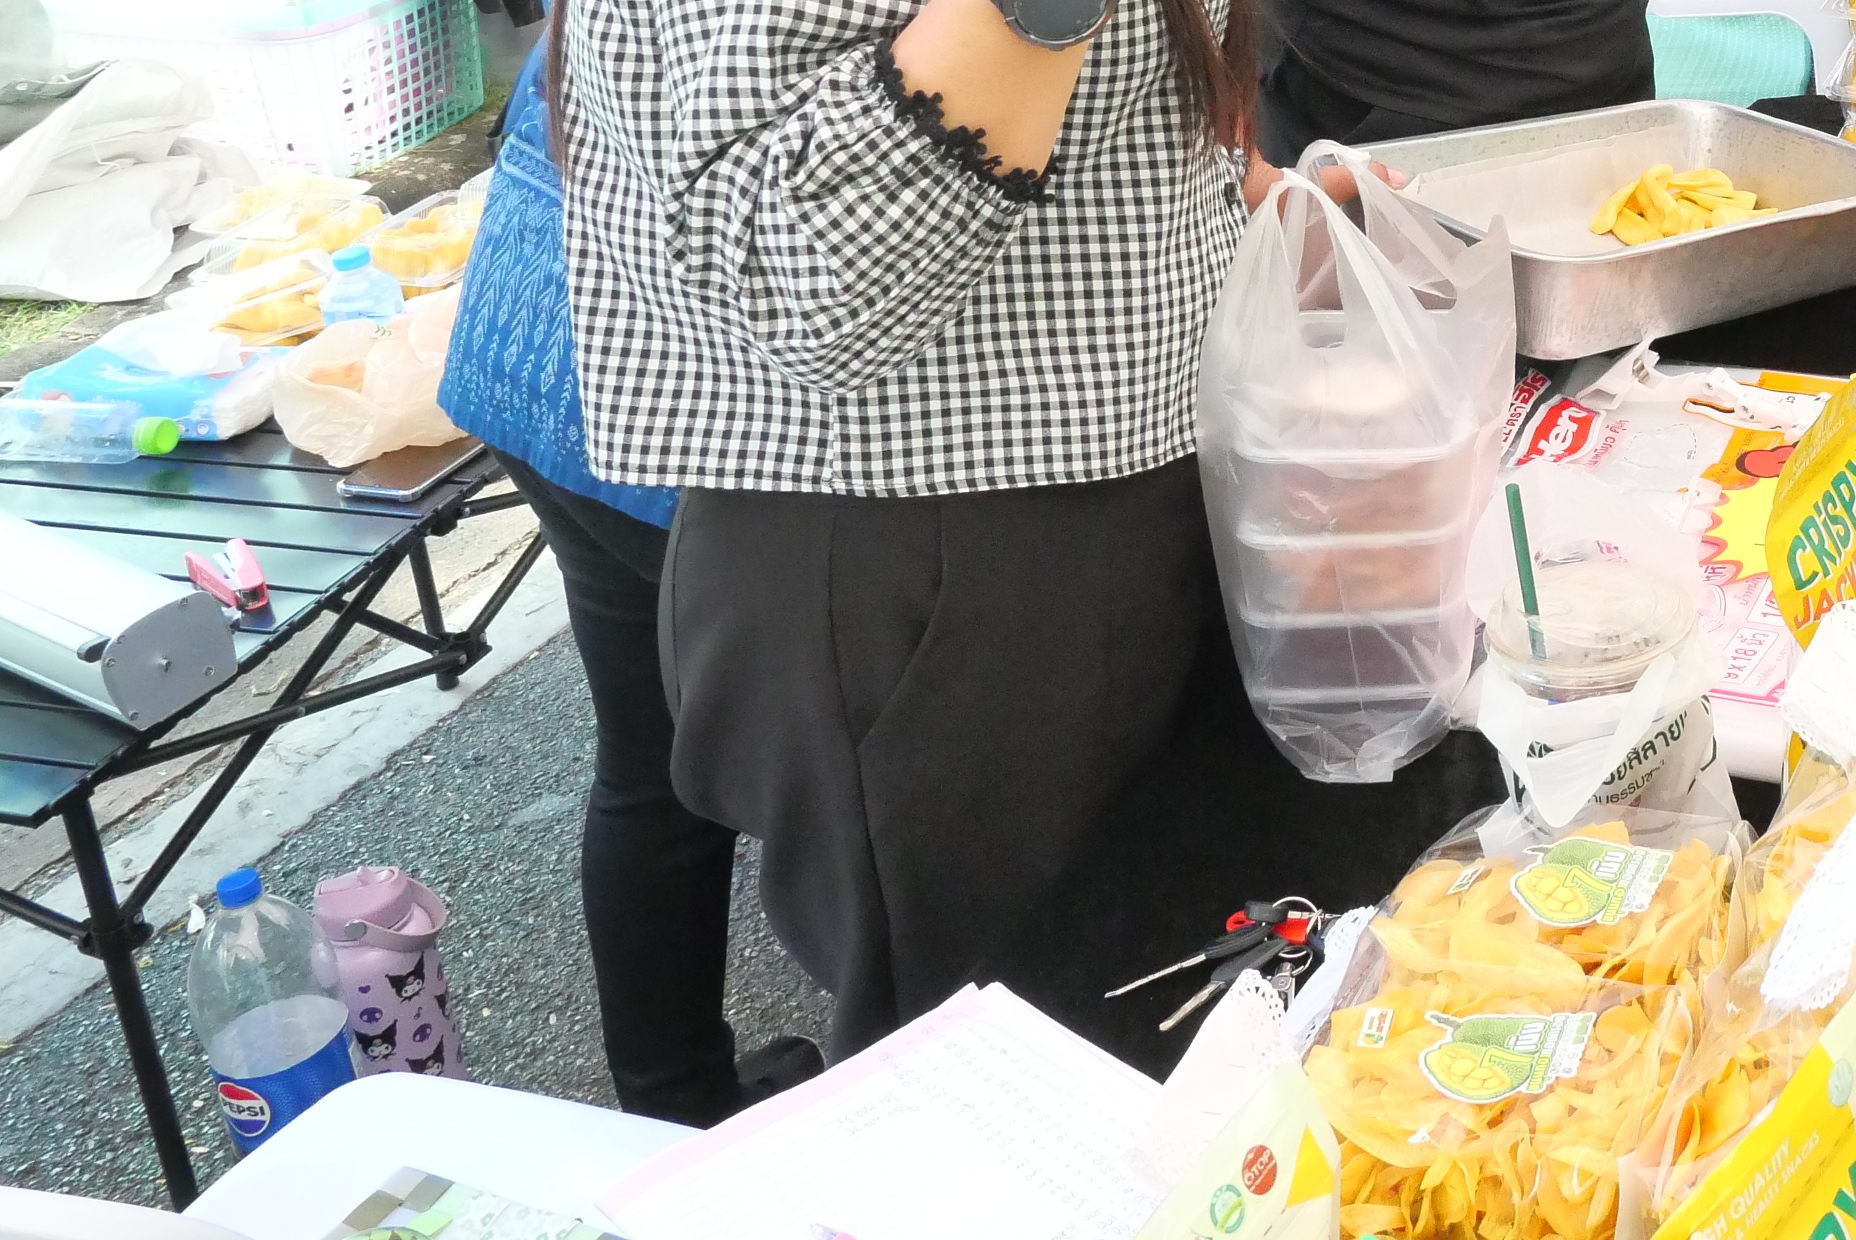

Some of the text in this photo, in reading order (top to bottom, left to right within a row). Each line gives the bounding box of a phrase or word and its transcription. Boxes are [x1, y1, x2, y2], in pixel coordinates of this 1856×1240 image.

[222, 1098, 266, 1117] PEPSI
[1243, 1149, 1272, 1186] OTOP
[1730, 1137, 1791, 1220] QUALITY
[1781, 1130, 1821, 1185] SNACKS
